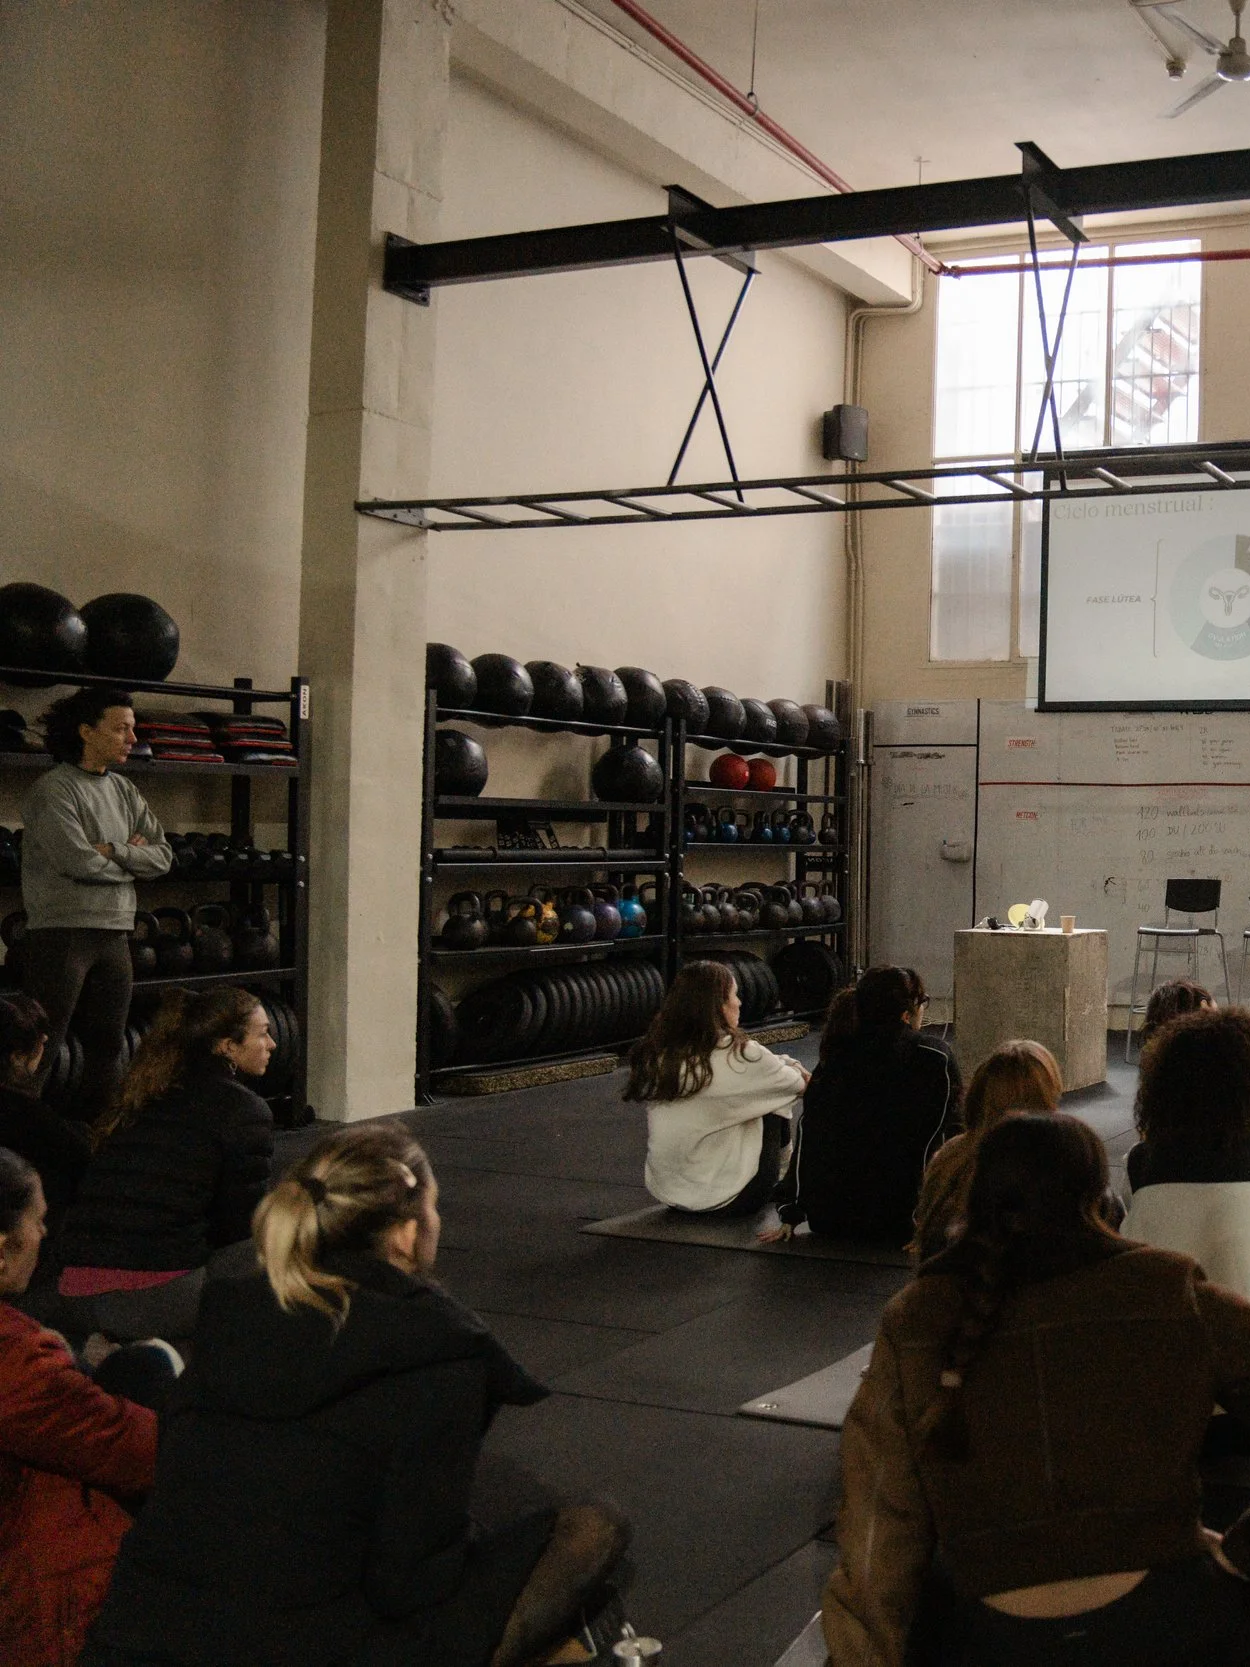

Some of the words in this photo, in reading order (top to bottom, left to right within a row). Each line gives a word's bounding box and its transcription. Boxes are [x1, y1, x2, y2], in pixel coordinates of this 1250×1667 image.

[1054, 502, 1099, 520] Ciclo
[1105, 495, 1202, 518] menstrual
[1086, 595, 1110, 604] FASE
